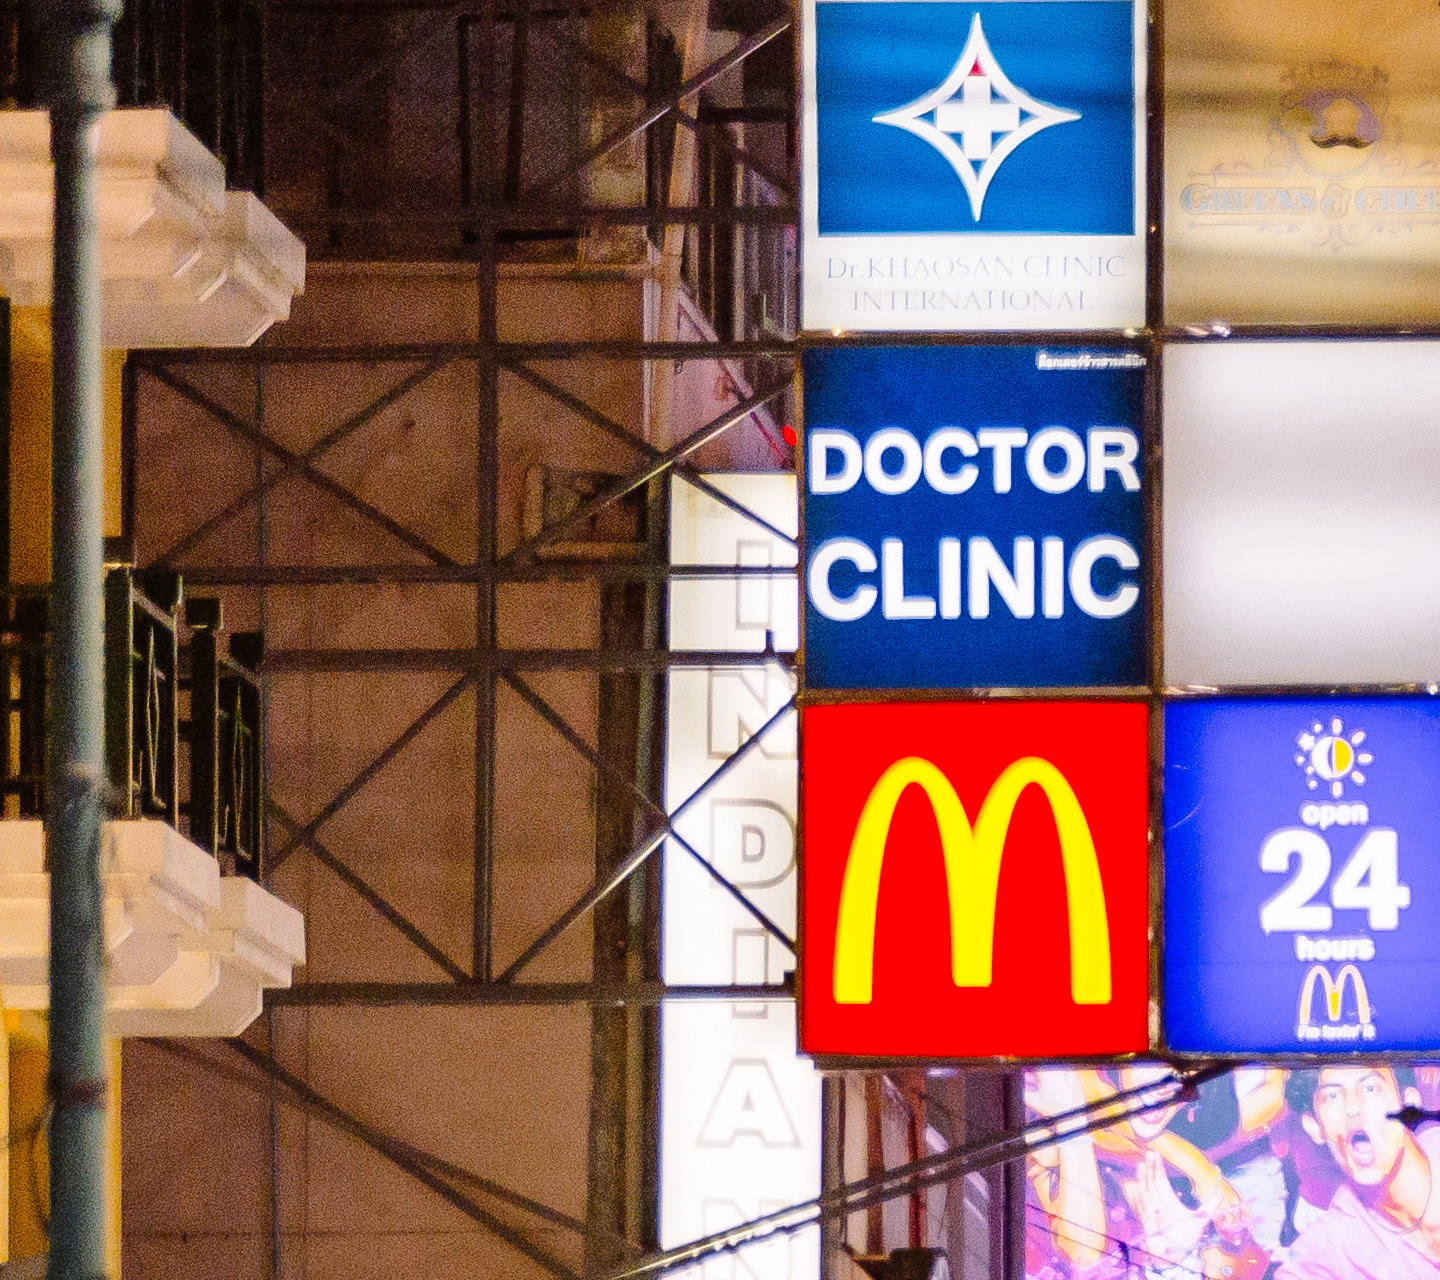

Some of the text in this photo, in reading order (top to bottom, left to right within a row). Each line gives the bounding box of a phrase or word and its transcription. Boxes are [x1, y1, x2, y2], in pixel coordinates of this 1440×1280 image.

[1023, 254, 1126, 279] CLINIC
[851, 289, 1095, 312] INTERNATIONAL
[809, 426, 1142, 495] DOCTOR
[809, 536, 1141, 621] CLINIC
[1301, 802, 1369, 831] open
[1258, 826, 1412, 932] 24
[1296, 935, 1376, 962] hours
